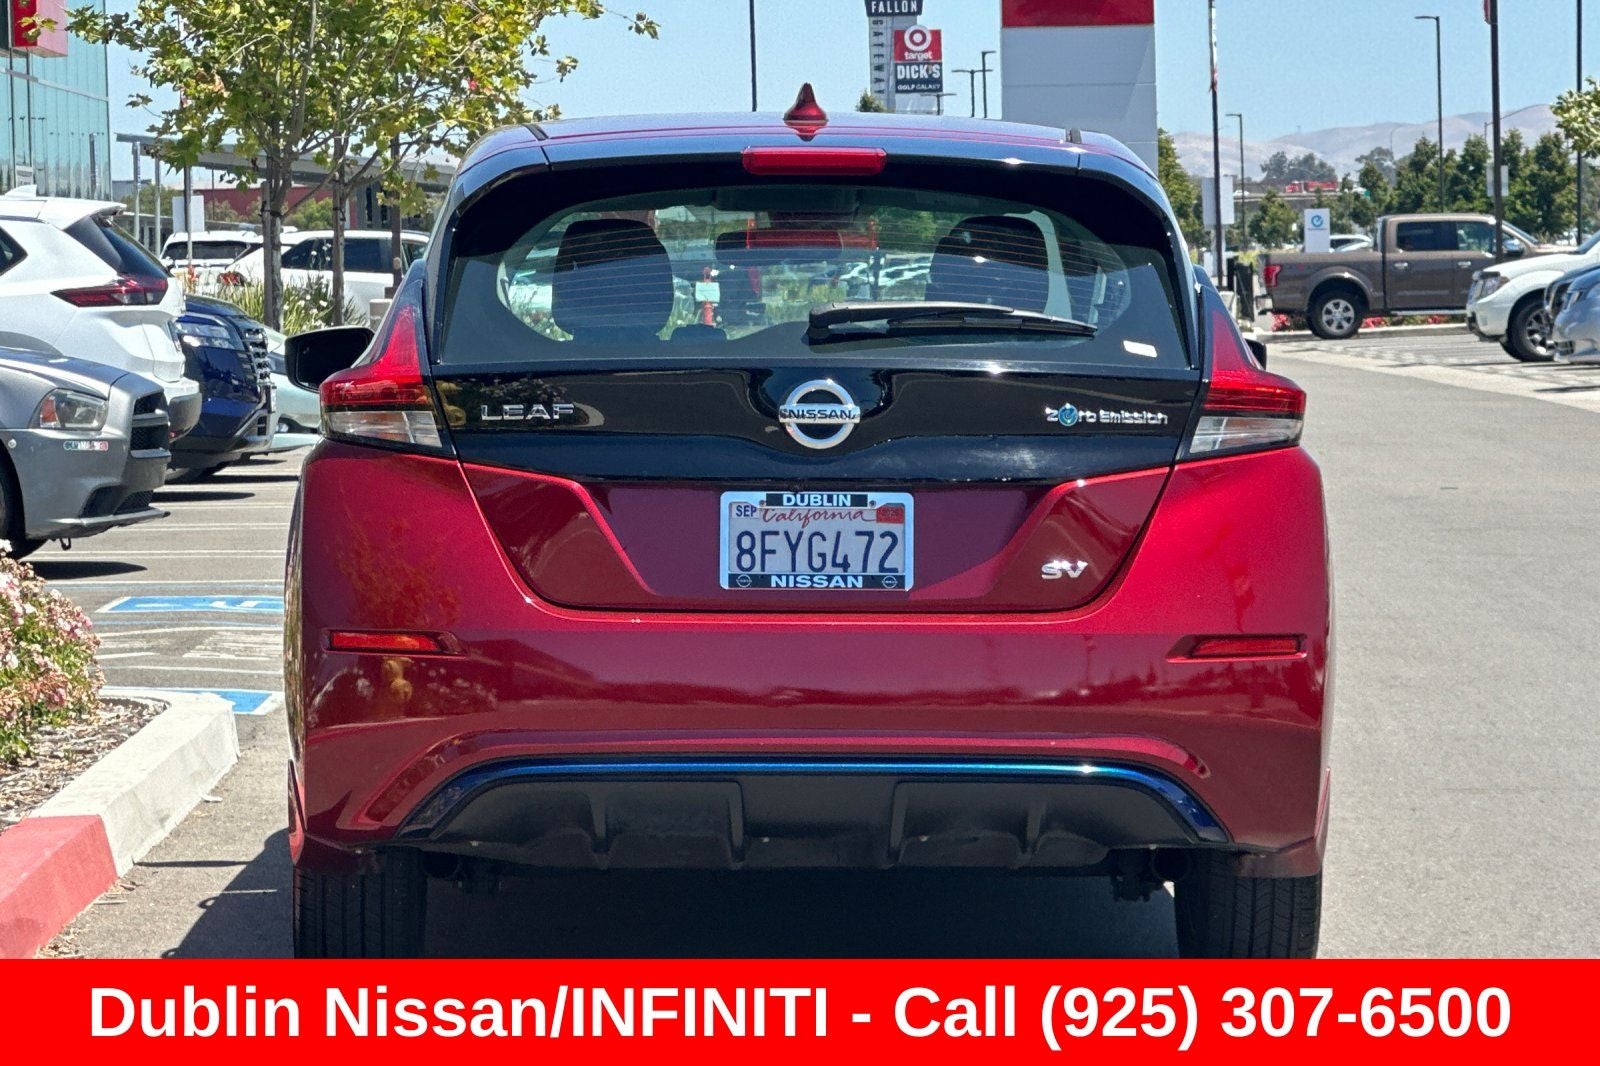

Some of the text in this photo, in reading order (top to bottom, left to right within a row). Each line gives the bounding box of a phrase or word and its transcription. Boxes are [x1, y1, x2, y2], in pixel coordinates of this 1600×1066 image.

[871, 0, 918, 13] FALLON
[872, 19, 885, 95] GATEWAY
[904, 51, 933, 61] target
[896, 64, 941, 79] DICK'S
[480, 403, 575, 420] LEAF
[788, 408, 853, 420] NISSAN
[1099, 409, 1168, 424] Emission
[782, 494, 851, 507] DUBLIN
[735, 504, 758, 518] SEP
[762, 508, 877, 529] California
[736, 530, 899, 573] 8FYG472
[1041, 559, 1088, 579] SV
[770, 575, 864, 588] NISSAN
